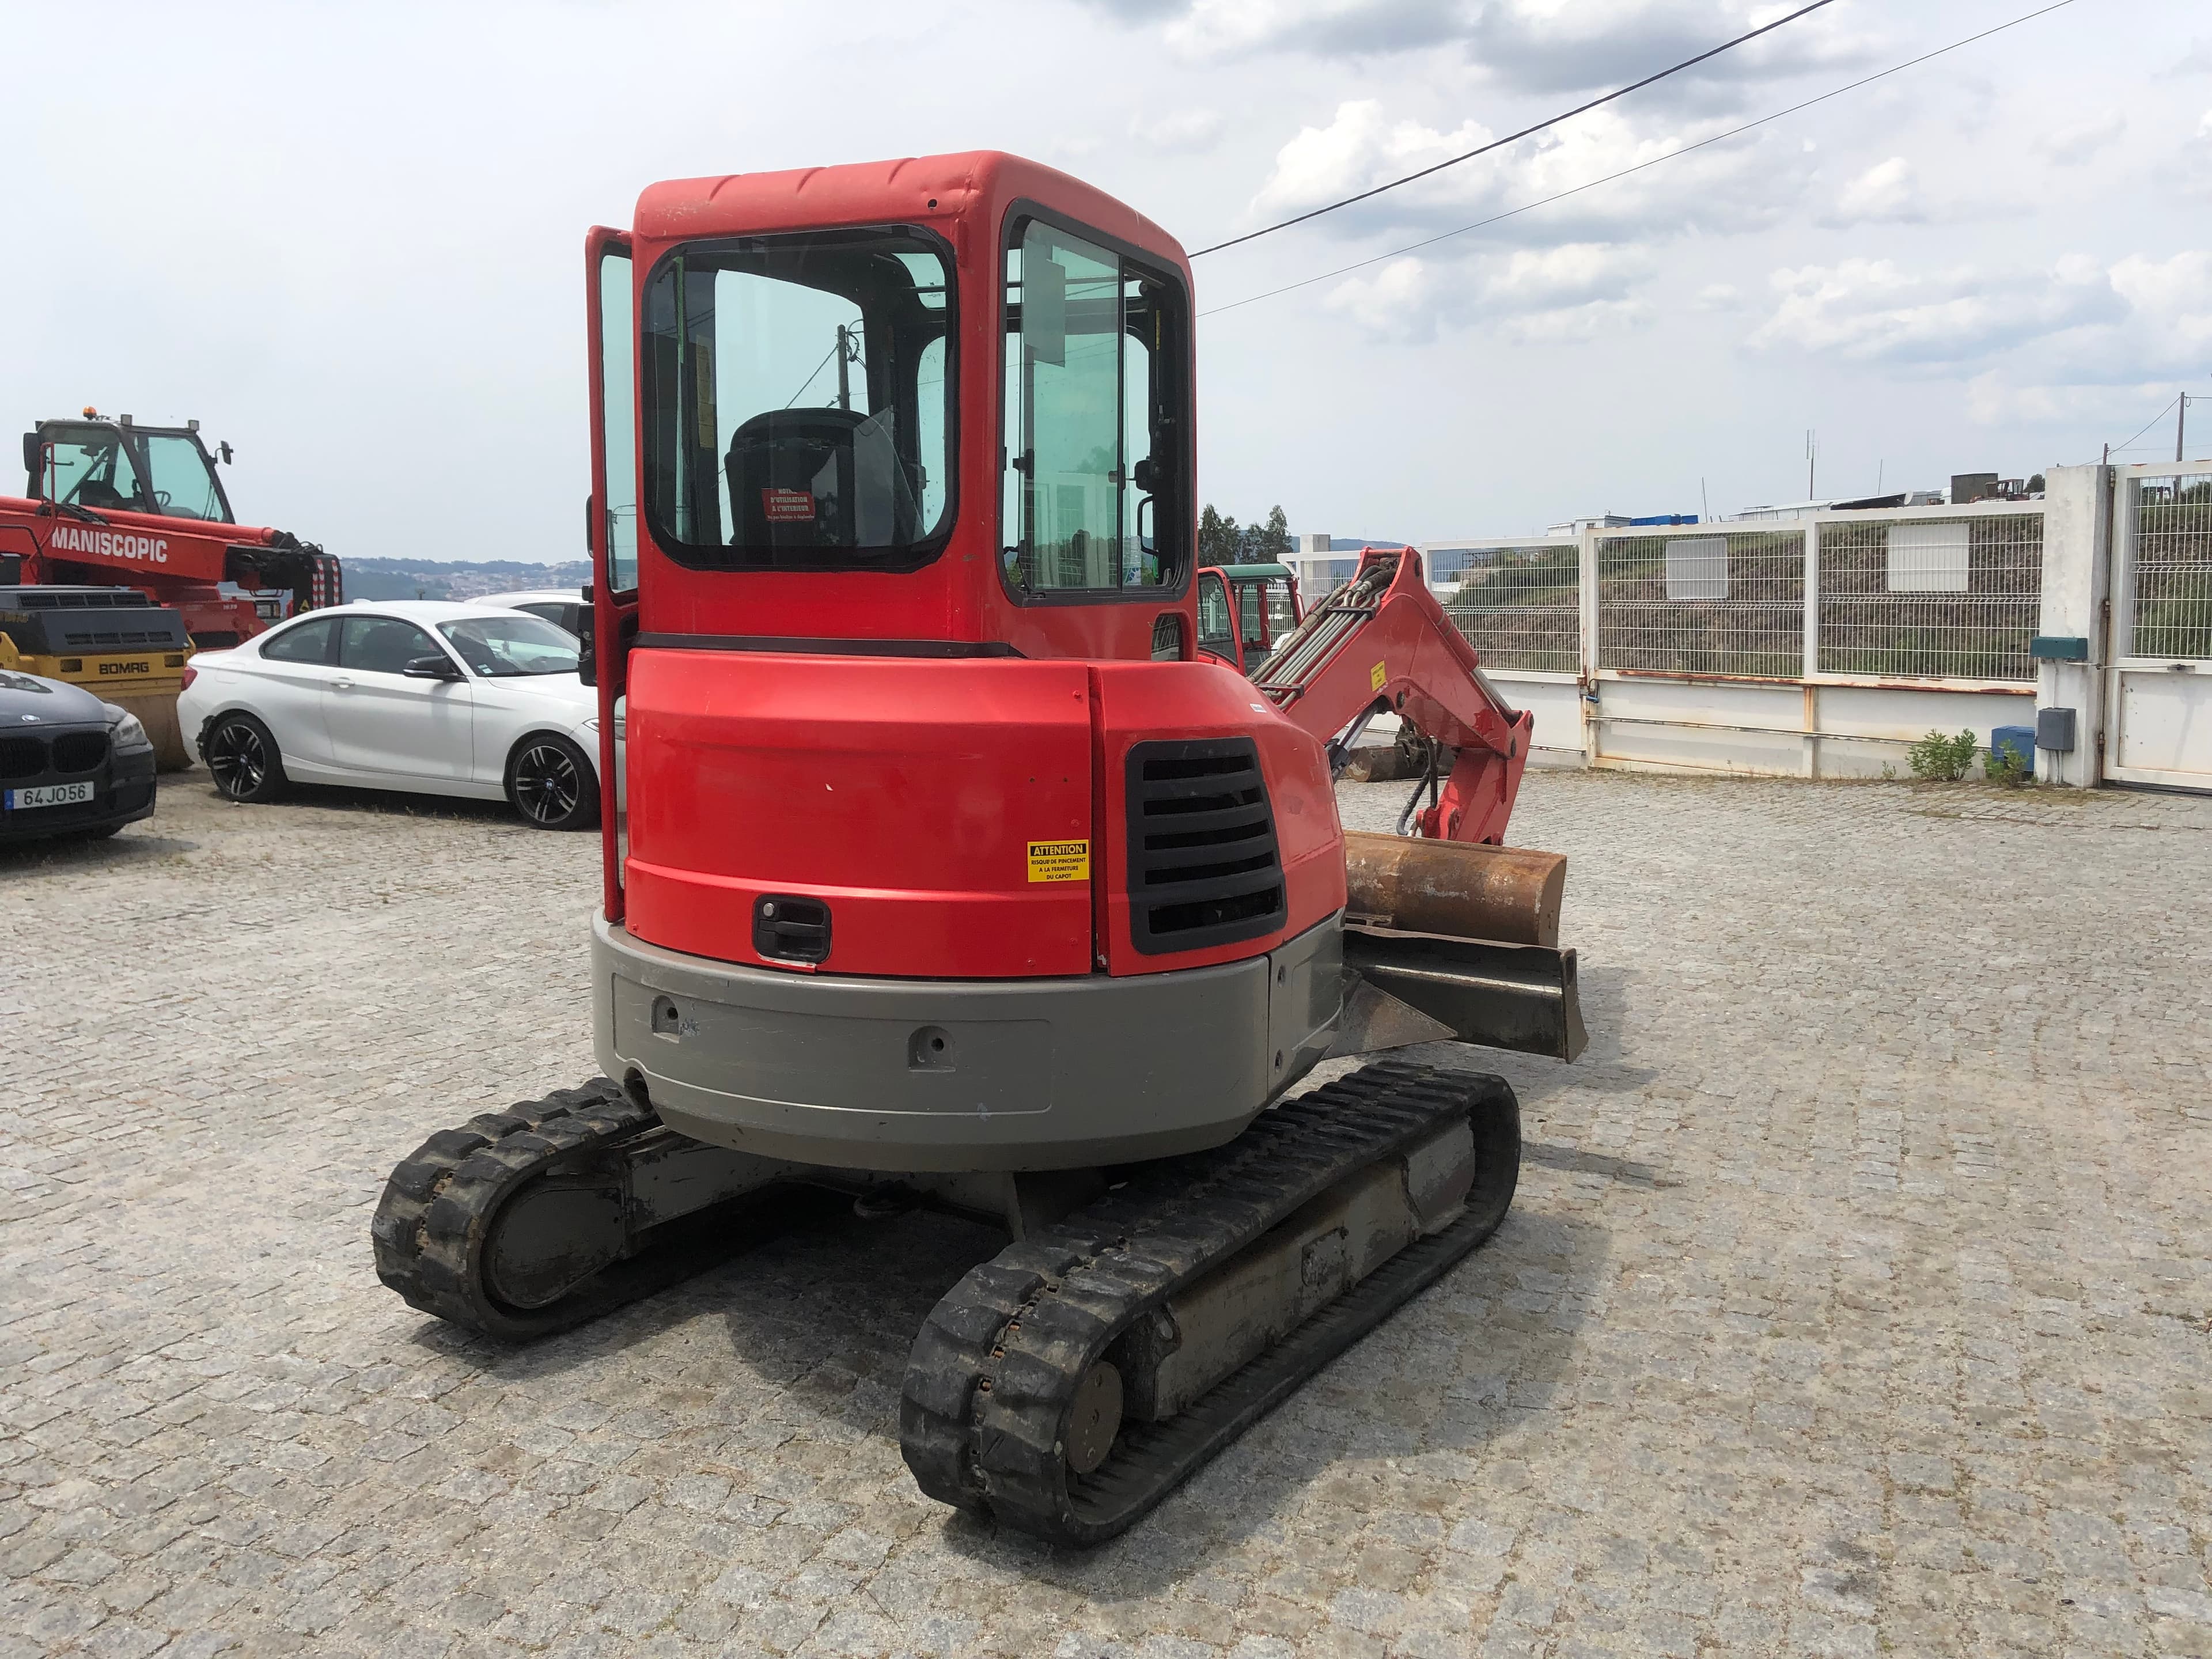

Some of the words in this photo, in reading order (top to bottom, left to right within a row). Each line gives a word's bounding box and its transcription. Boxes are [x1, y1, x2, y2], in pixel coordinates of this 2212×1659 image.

[52, 527, 167, 563] MANISCOPIC
[99, 662, 149, 675] BOMAG
[1033, 844, 1083, 856] ATTENTION
